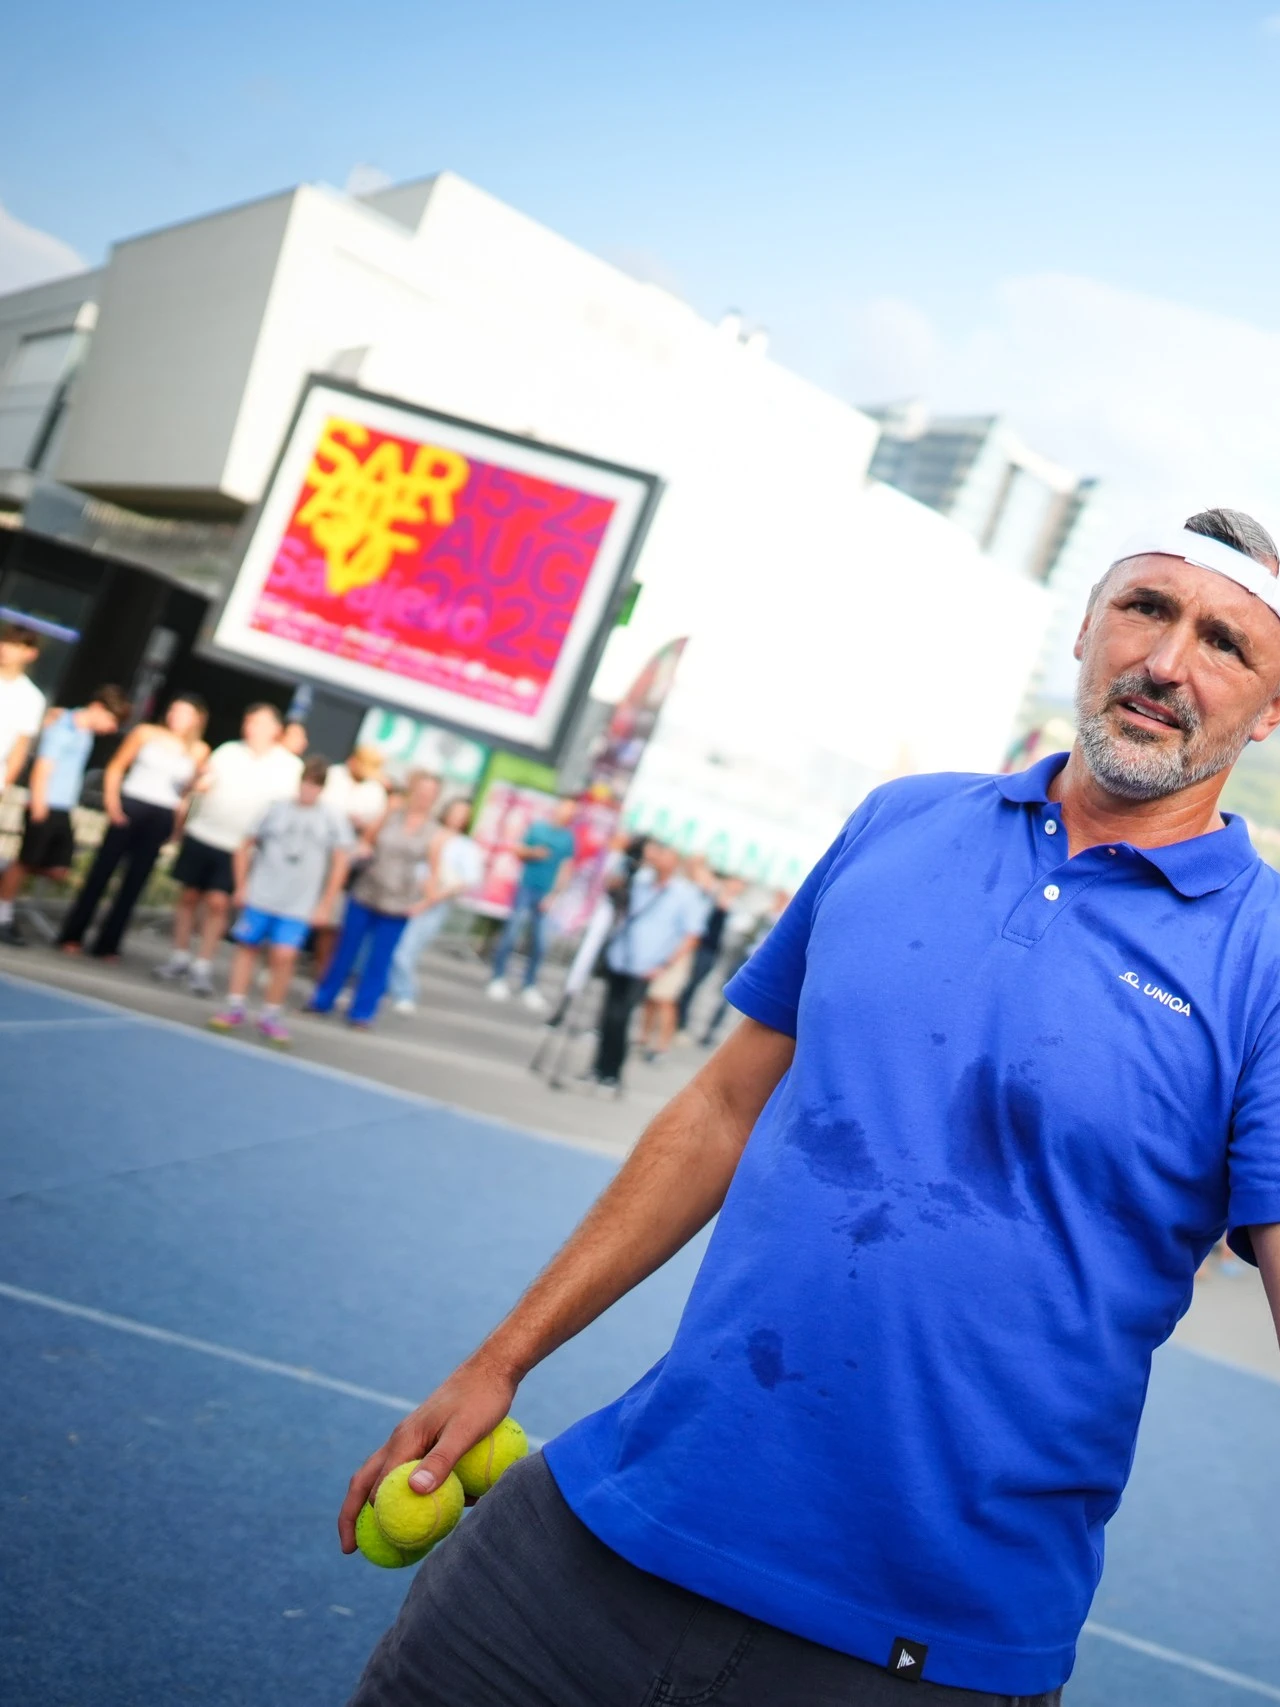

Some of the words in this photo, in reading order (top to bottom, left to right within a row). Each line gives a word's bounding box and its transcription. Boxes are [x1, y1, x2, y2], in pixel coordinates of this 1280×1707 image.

[306, 415, 471, 525] SAR
[267, 536, 487, 646] Saajevo
[423, 514, 588, 604] AUG
[1142, 982, 1192, 1017] UNIQA
